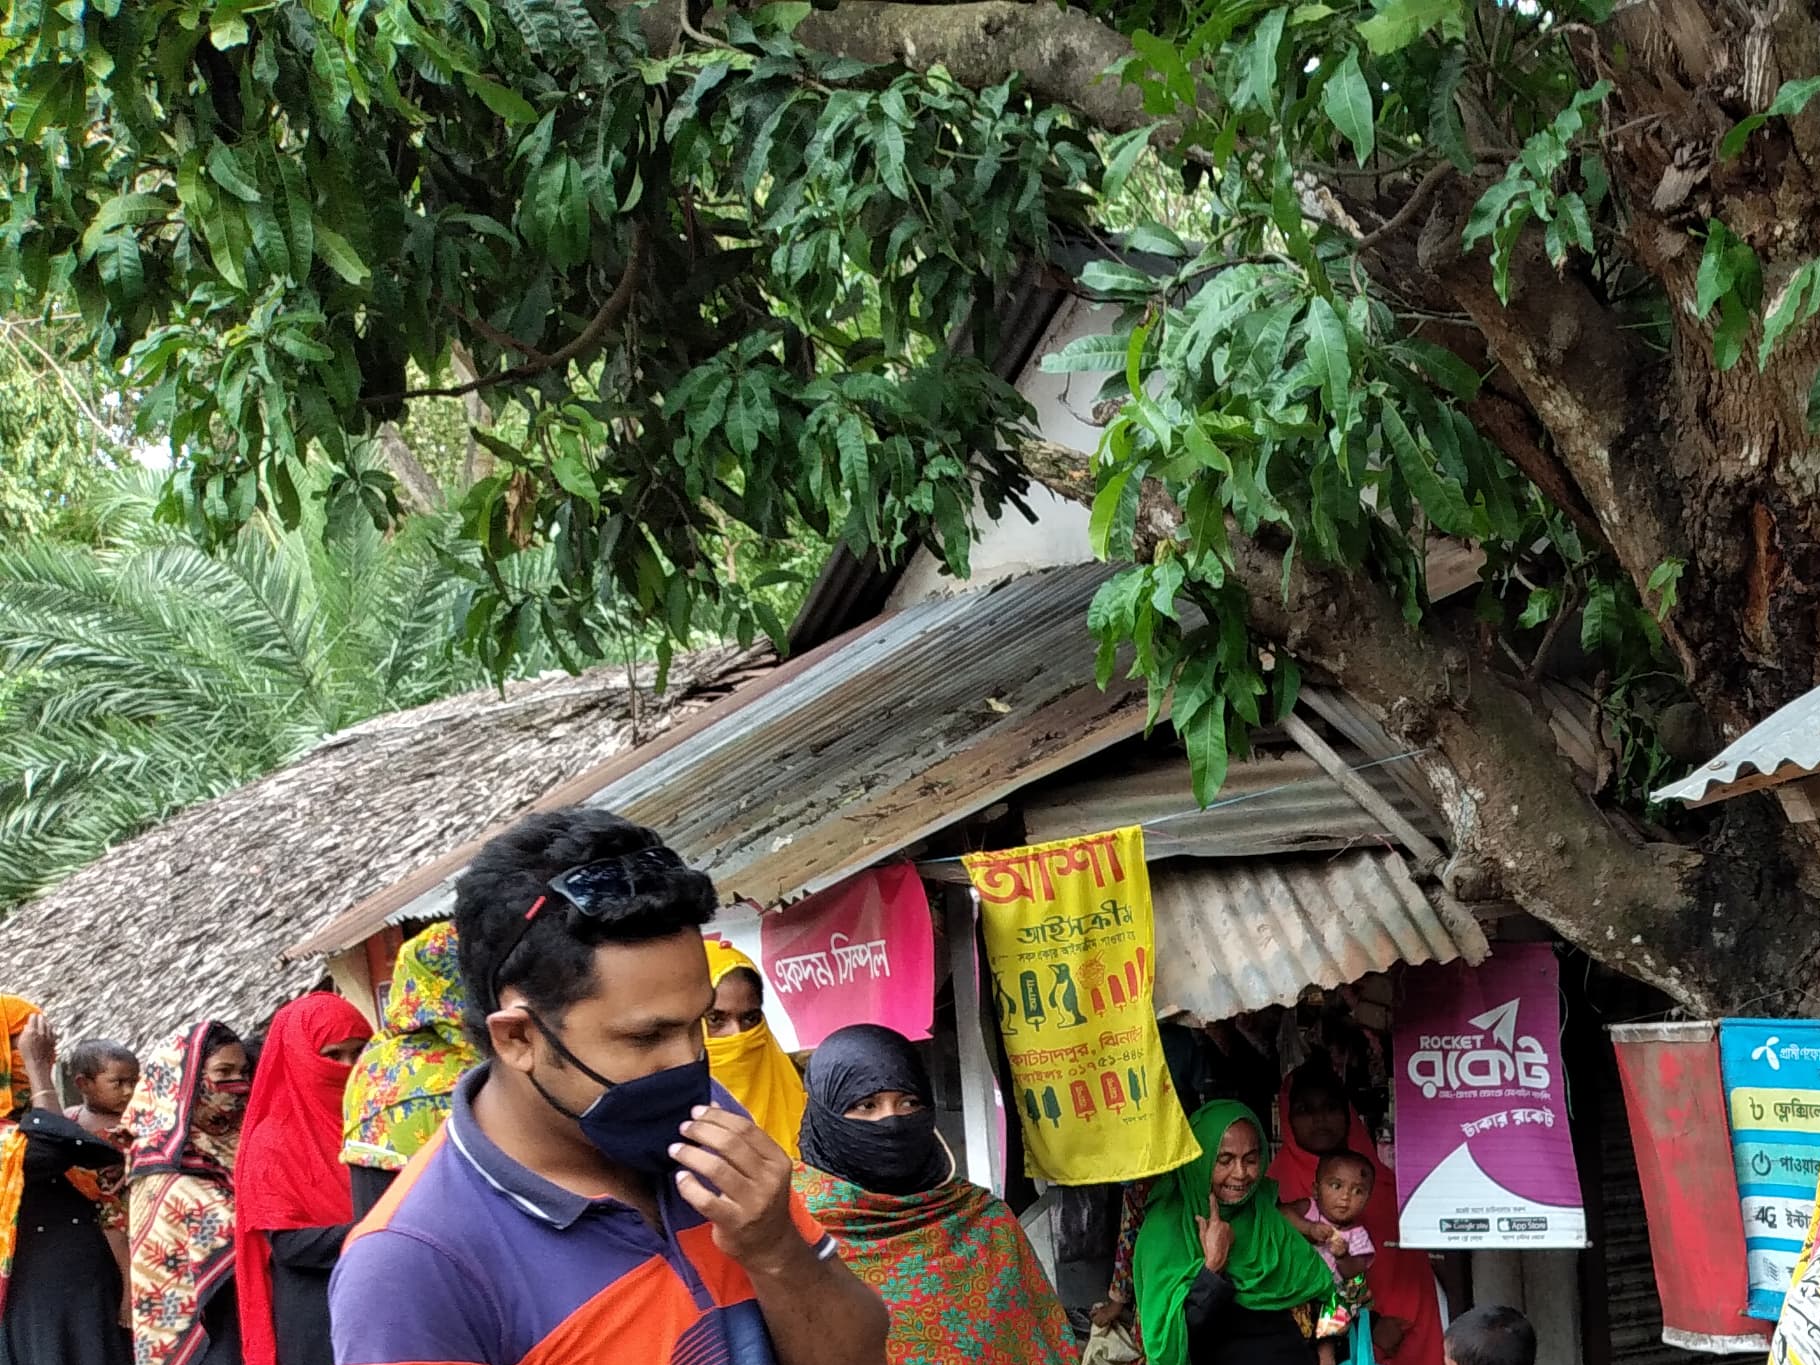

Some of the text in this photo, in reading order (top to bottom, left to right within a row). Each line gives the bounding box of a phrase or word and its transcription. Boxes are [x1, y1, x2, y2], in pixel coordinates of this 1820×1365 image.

[968, 832, 1126, 904] আশা
[774, 932, 891, 996] একদম সিম্পল
[1419, 1034, 1485, 1050] ROCKET
[1406, 1035, 1552, 1100] রকেট
[1460, 1105, 1556, 1140] টাকার রকেট
[1511, 1221, 1527, 1232] App
